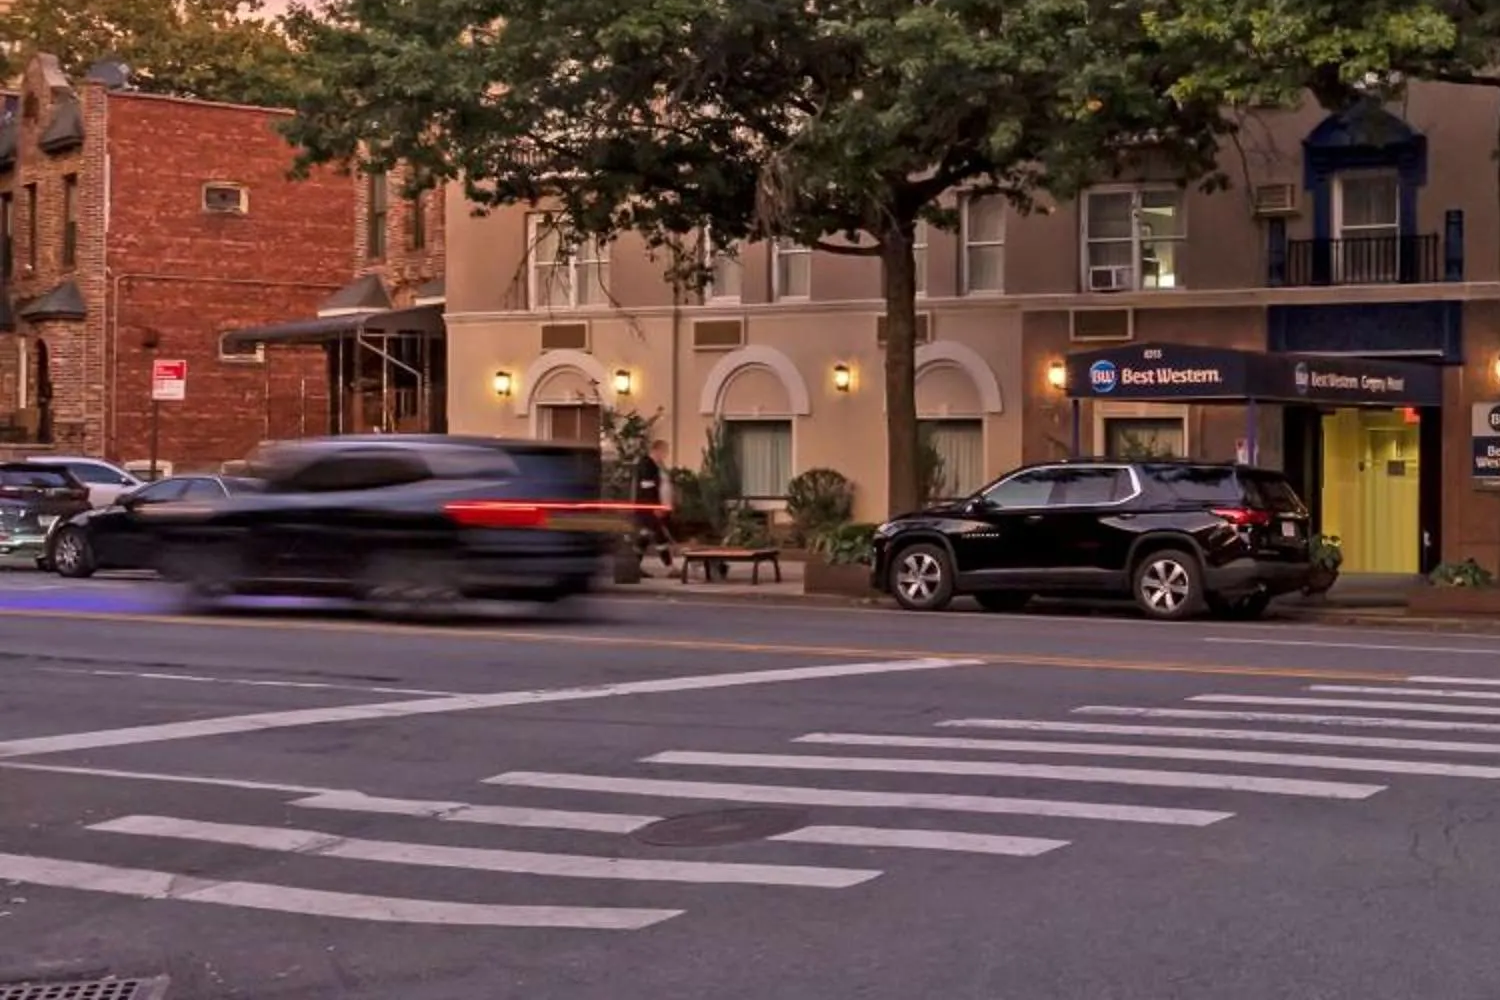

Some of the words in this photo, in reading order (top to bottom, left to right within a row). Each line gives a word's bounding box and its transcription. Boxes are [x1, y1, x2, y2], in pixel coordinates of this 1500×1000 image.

[1091, 370, 1115, 384] BW
[1122, 368, 1154, 384] Best
[1156, 368, 1220, 383] Western
